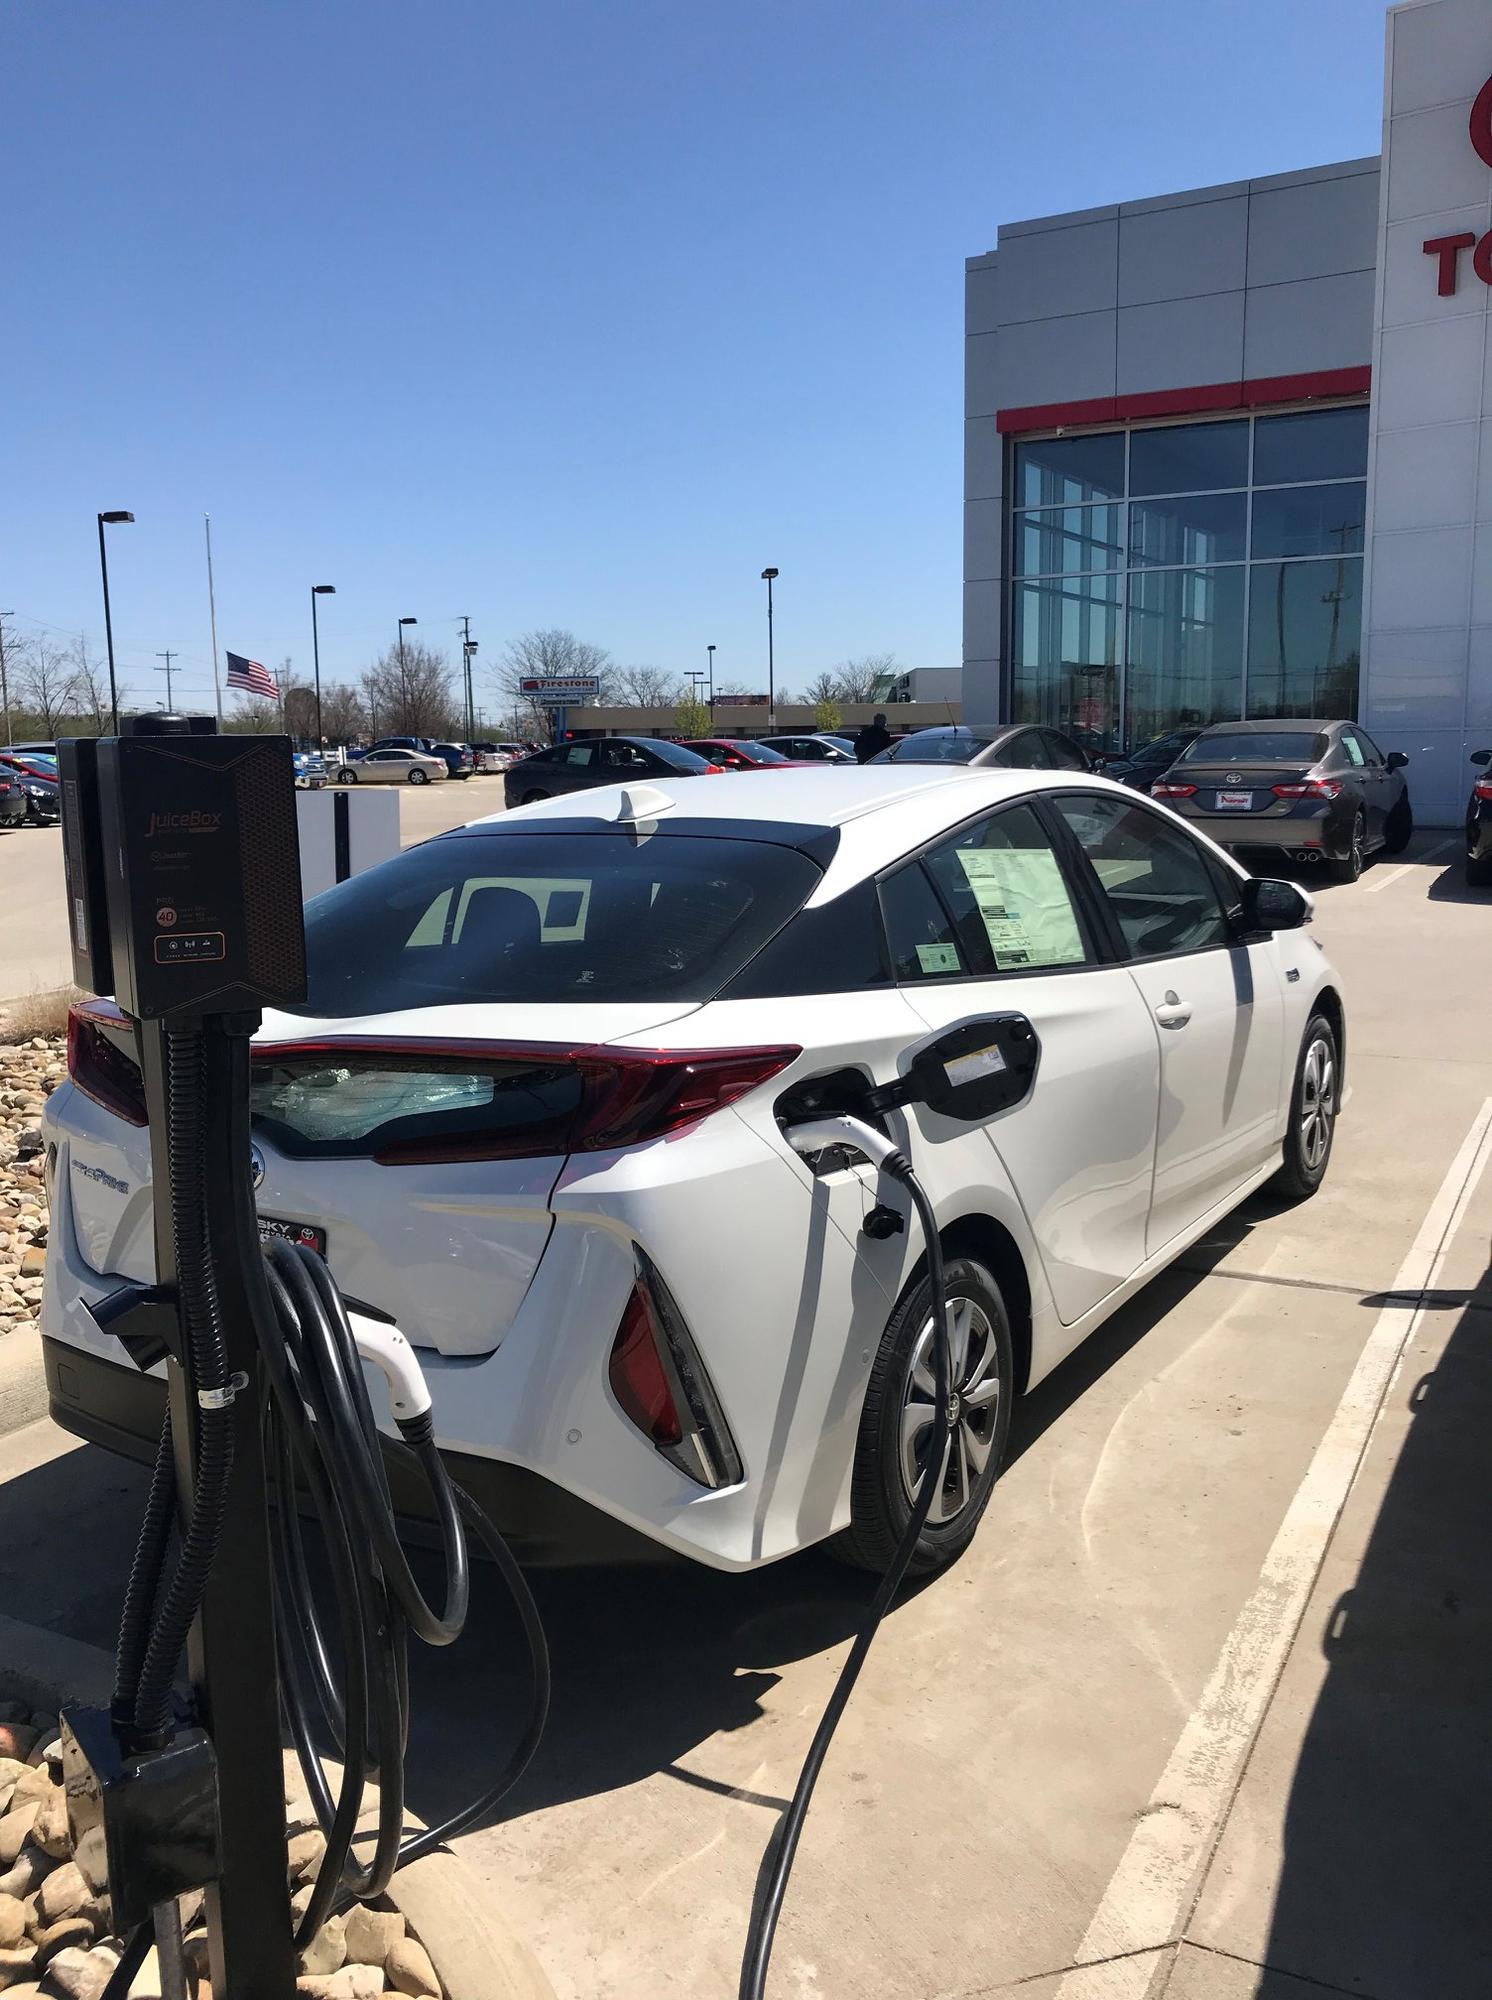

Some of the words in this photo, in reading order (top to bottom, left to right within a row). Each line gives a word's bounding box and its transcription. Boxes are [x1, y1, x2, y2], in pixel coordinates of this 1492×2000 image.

[539, 680, 596, 689] Firestone
[143, 811, 222, 838] JuiceBox
[158, 911, 174, 922] 40
